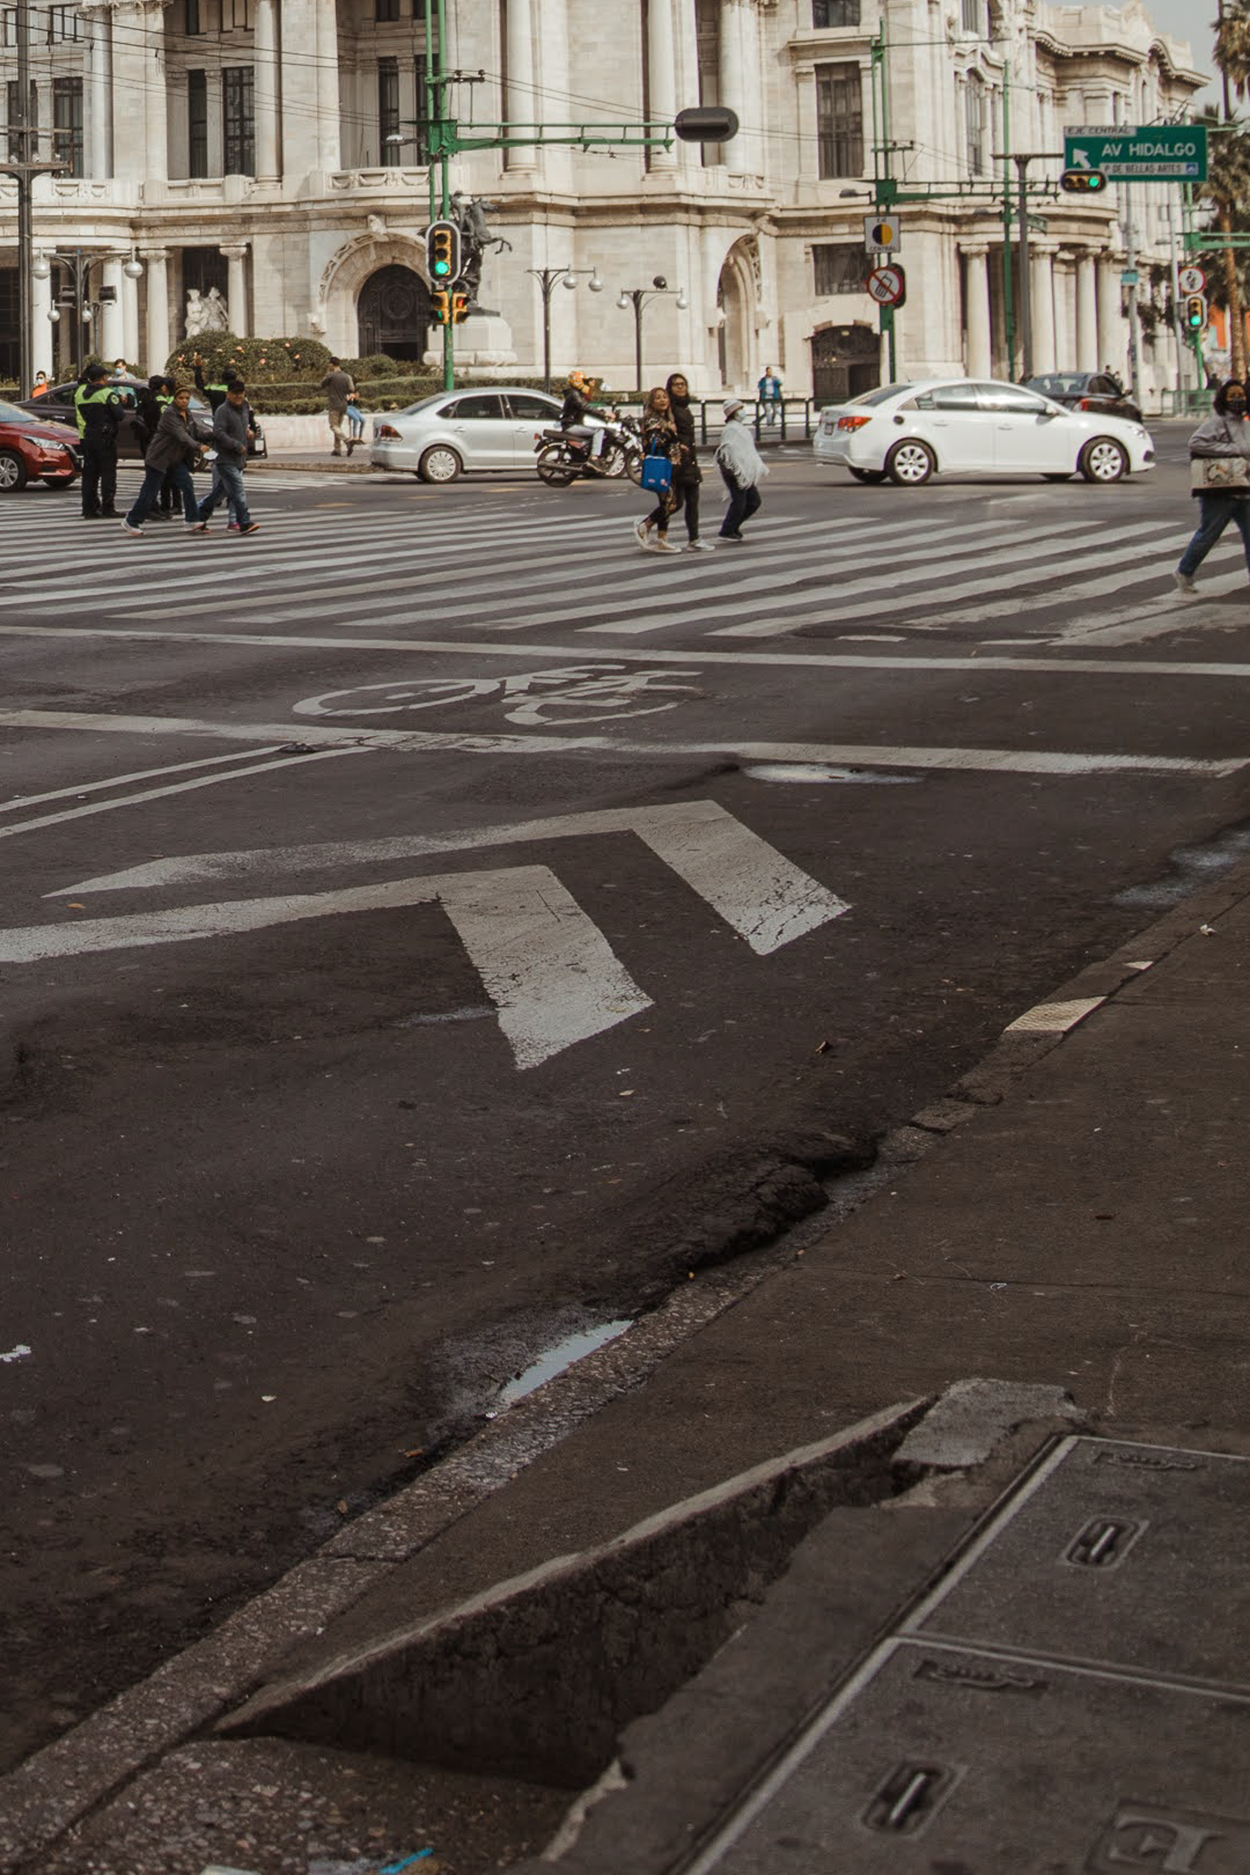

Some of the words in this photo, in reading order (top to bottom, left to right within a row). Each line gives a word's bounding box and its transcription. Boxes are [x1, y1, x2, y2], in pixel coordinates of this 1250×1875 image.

[1067, 126, 1086, 135] EJE
[1087, 126, 1130, 135] CENTRAL
[1101, 143, 1123, 157] AV
[1129, 142, 1196, 157] HIDALGO
[1112, 164, 1121, 174] DE
[1123, 164, 1153, 174] BELLAS
[1157, 164, 1182, 174] ARTES
